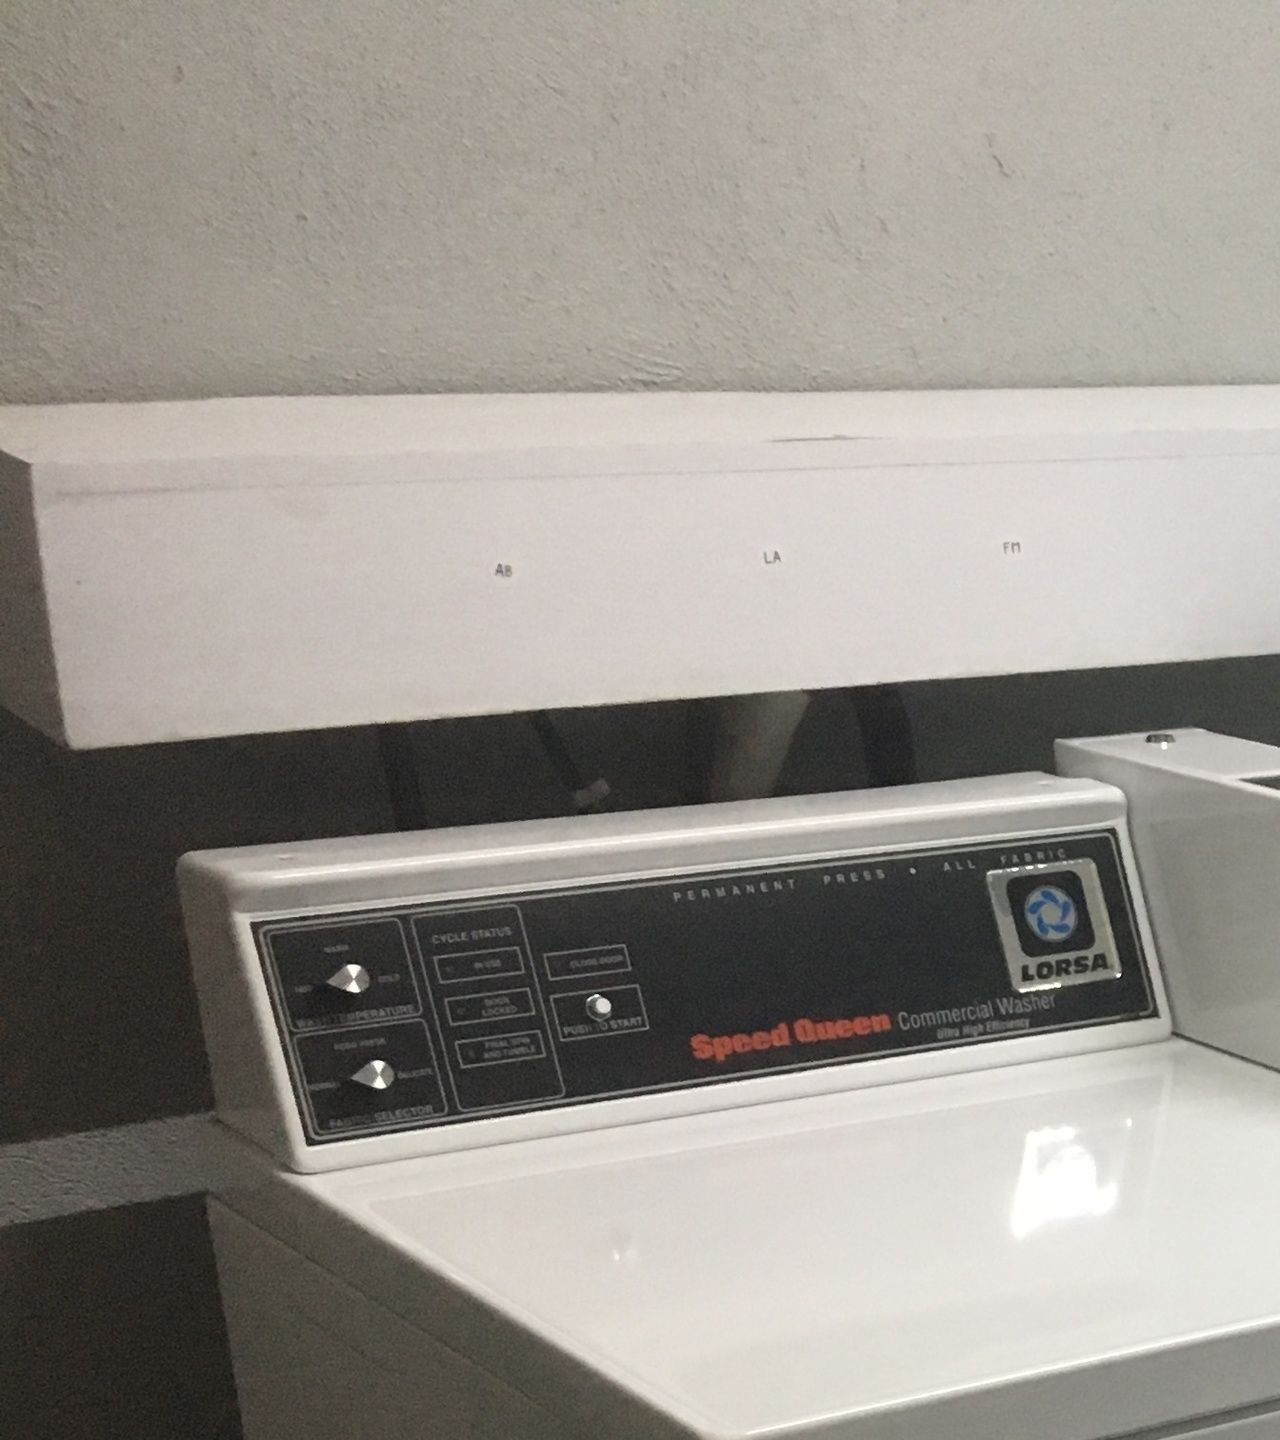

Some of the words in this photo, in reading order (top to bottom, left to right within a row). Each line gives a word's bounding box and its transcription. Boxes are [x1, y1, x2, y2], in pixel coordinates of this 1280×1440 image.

[673, 878, 797, 902] PERMANENT
[823, 868, 887, 886] PRESS
[943, 858, 977, 873] ALL
[431, 932, 468, 944] CYCLE
[1021, 953, 1110, 983] LORSA
[609, 1016, 642, 1029] START
[690, 1023, 790, 1063] Speed
[794, 1012, 892, 1044] Queen
[897, 1000, 993, 1031] Commercial
[997, 991, 1057, 1015] Washer
[374, 1105, 434, 1121] SELECTOR
